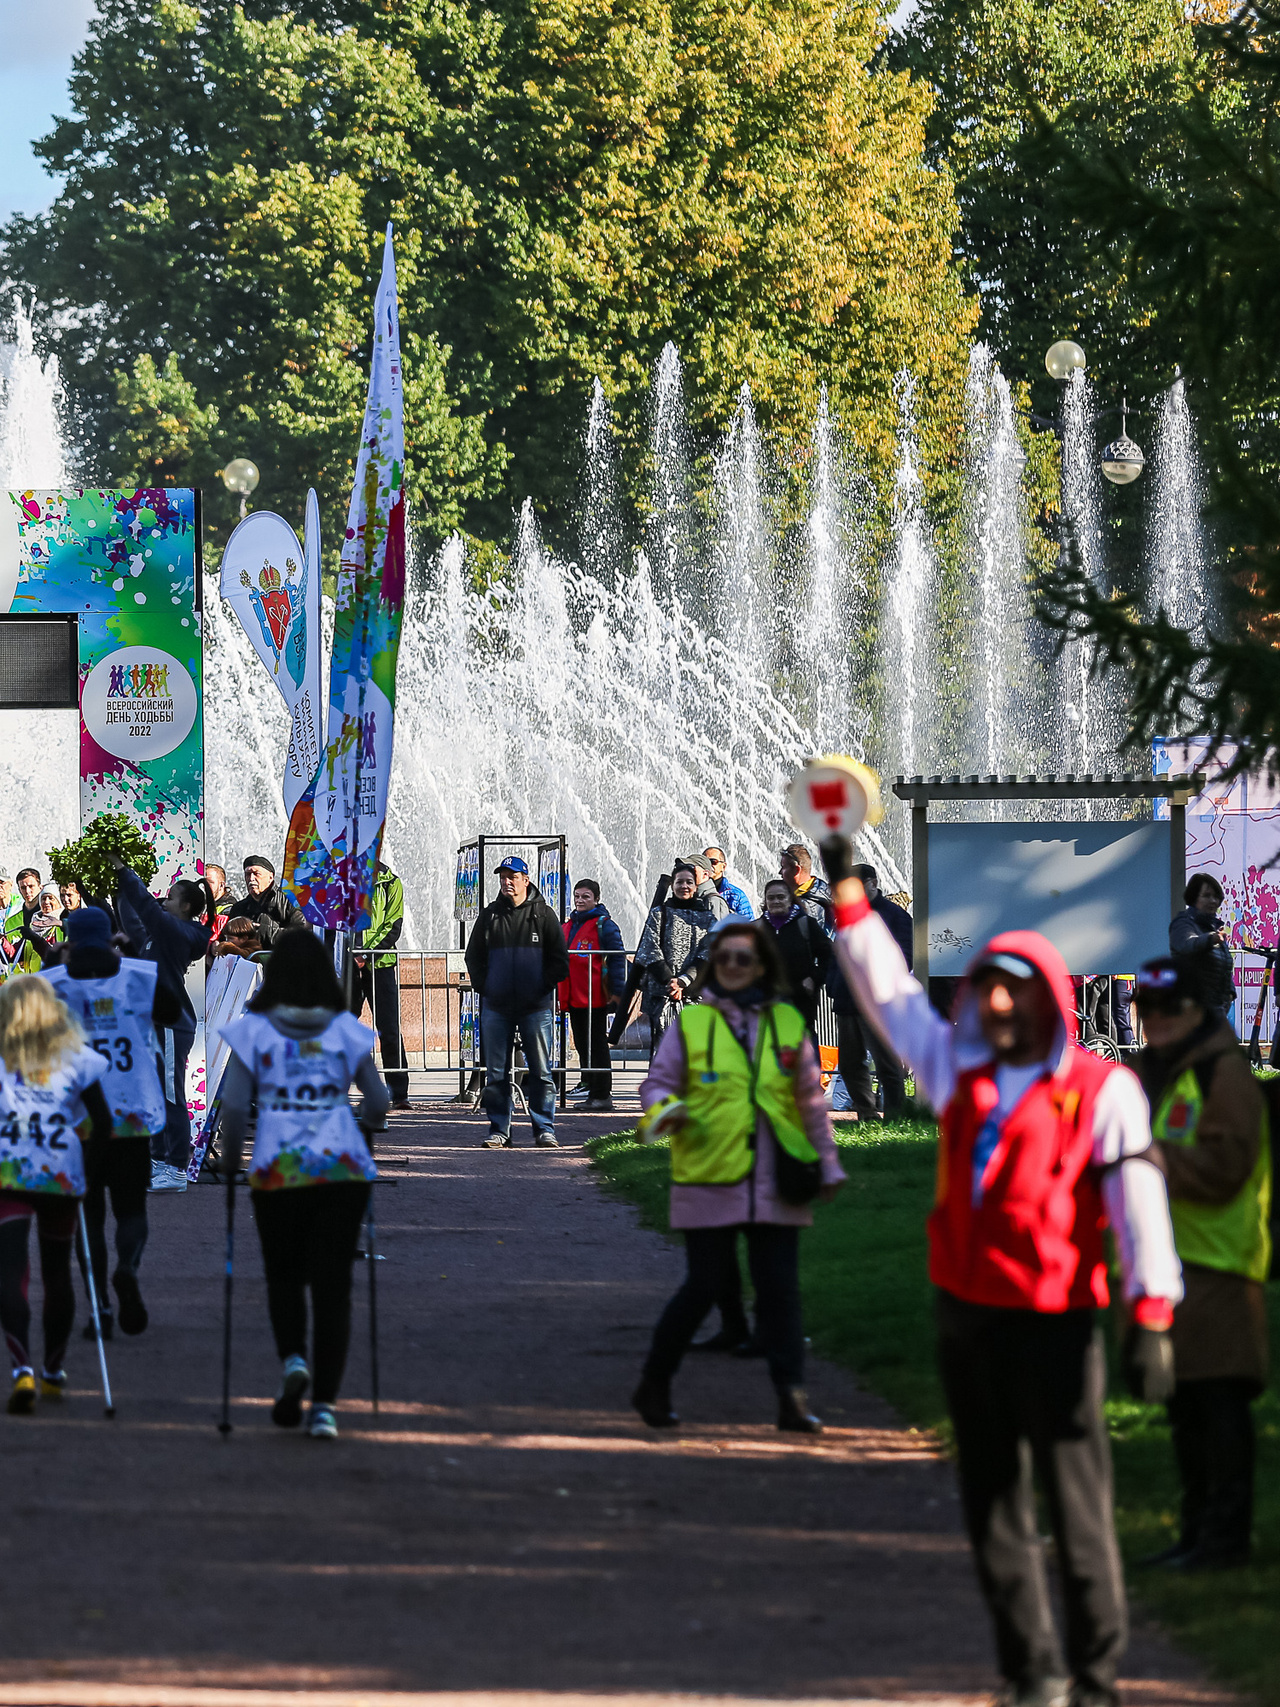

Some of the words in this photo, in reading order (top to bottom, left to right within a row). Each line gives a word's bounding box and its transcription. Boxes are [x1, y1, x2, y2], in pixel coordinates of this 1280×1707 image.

[106, 699, 173, 711] ВСЕРОССИЙСКИЙ
[106, 712, 131, 724] ДЕНЬ
[134, 711, 173, 724] ХОДЬБЫ
[129, 726, 151, 736] 2022
[92, 1037, 133, 1072] 53
[0, 1111, 68, 1150] 442
